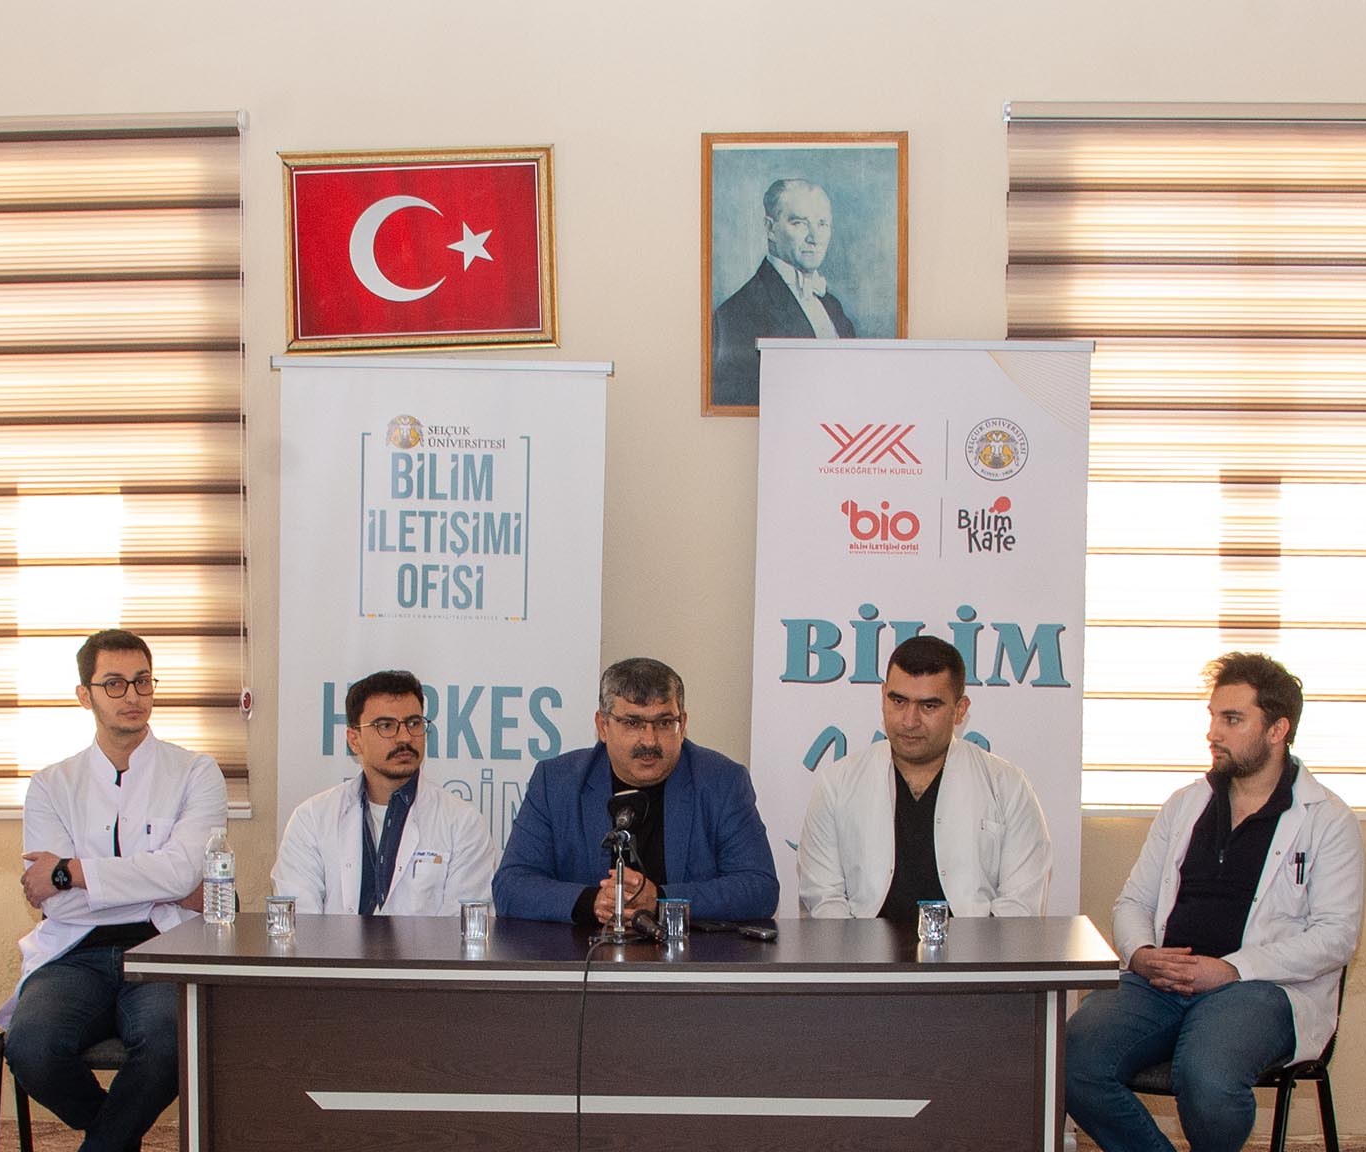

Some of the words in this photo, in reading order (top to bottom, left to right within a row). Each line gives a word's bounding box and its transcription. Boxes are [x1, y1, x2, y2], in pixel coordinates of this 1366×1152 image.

[427, 425, 471, 437] SELÇUK
[427, 437, 506, 449] ÜNİVERSİTESİ
[391, 452, 493, 501] BİLİM
[889, 467, 923, 476] KURULU
[368, 509, 522, 558] İLETİŞİMİ
[957, 508, 1012, 532] Bilim
[967, 526, 1016, 554] Kafe
[397, 563, 484, 610] OFİSİ
[322, 681, 563, 761] HRKES
